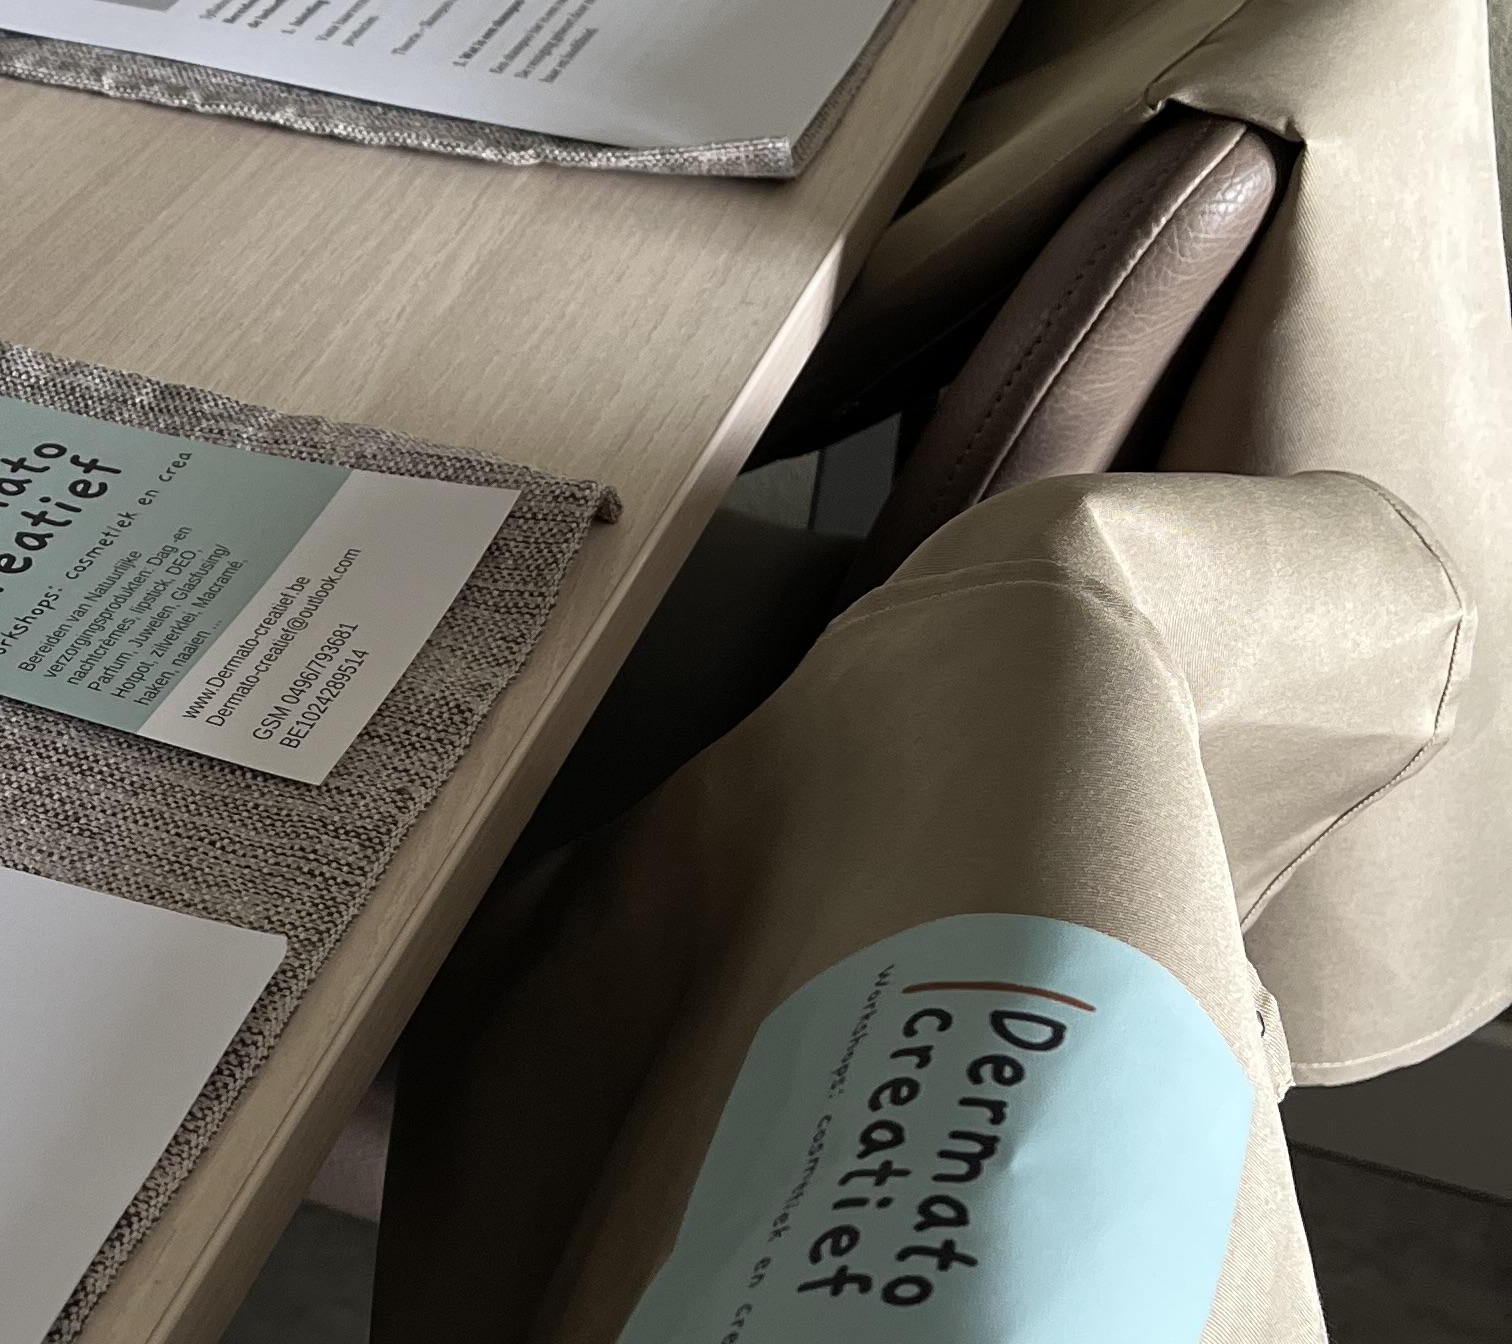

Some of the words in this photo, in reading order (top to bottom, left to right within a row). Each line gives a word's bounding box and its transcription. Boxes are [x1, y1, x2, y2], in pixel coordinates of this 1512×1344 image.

[65, 511, 137, 579] cosmetiek
[137, 489, 159, 505] en
[158, 452, 192, 482] crea
[145, 544, 179, 566] Dag
[17, 623, 72, 671] Bereiden
[65, 603, 92, 621] van
[83, 550, 142, 602] Natuurlijke
[171, 630, 211, 666] naaien
[182, 576, 311, 718] www.Dermato-creatief.be
[204, 548, 361, 726] Dermato-creatief@outlook.com
[252, 705, 292, 739] GSM
[280, 623, 359, 704] 0496/793681
[278, 649, 369, 748] BE1024289514
[797, 1008, 952, 1297] creatief
[881, 1010, 1066, 1306] Dermato
[749, 1257, 771, 1288] en
